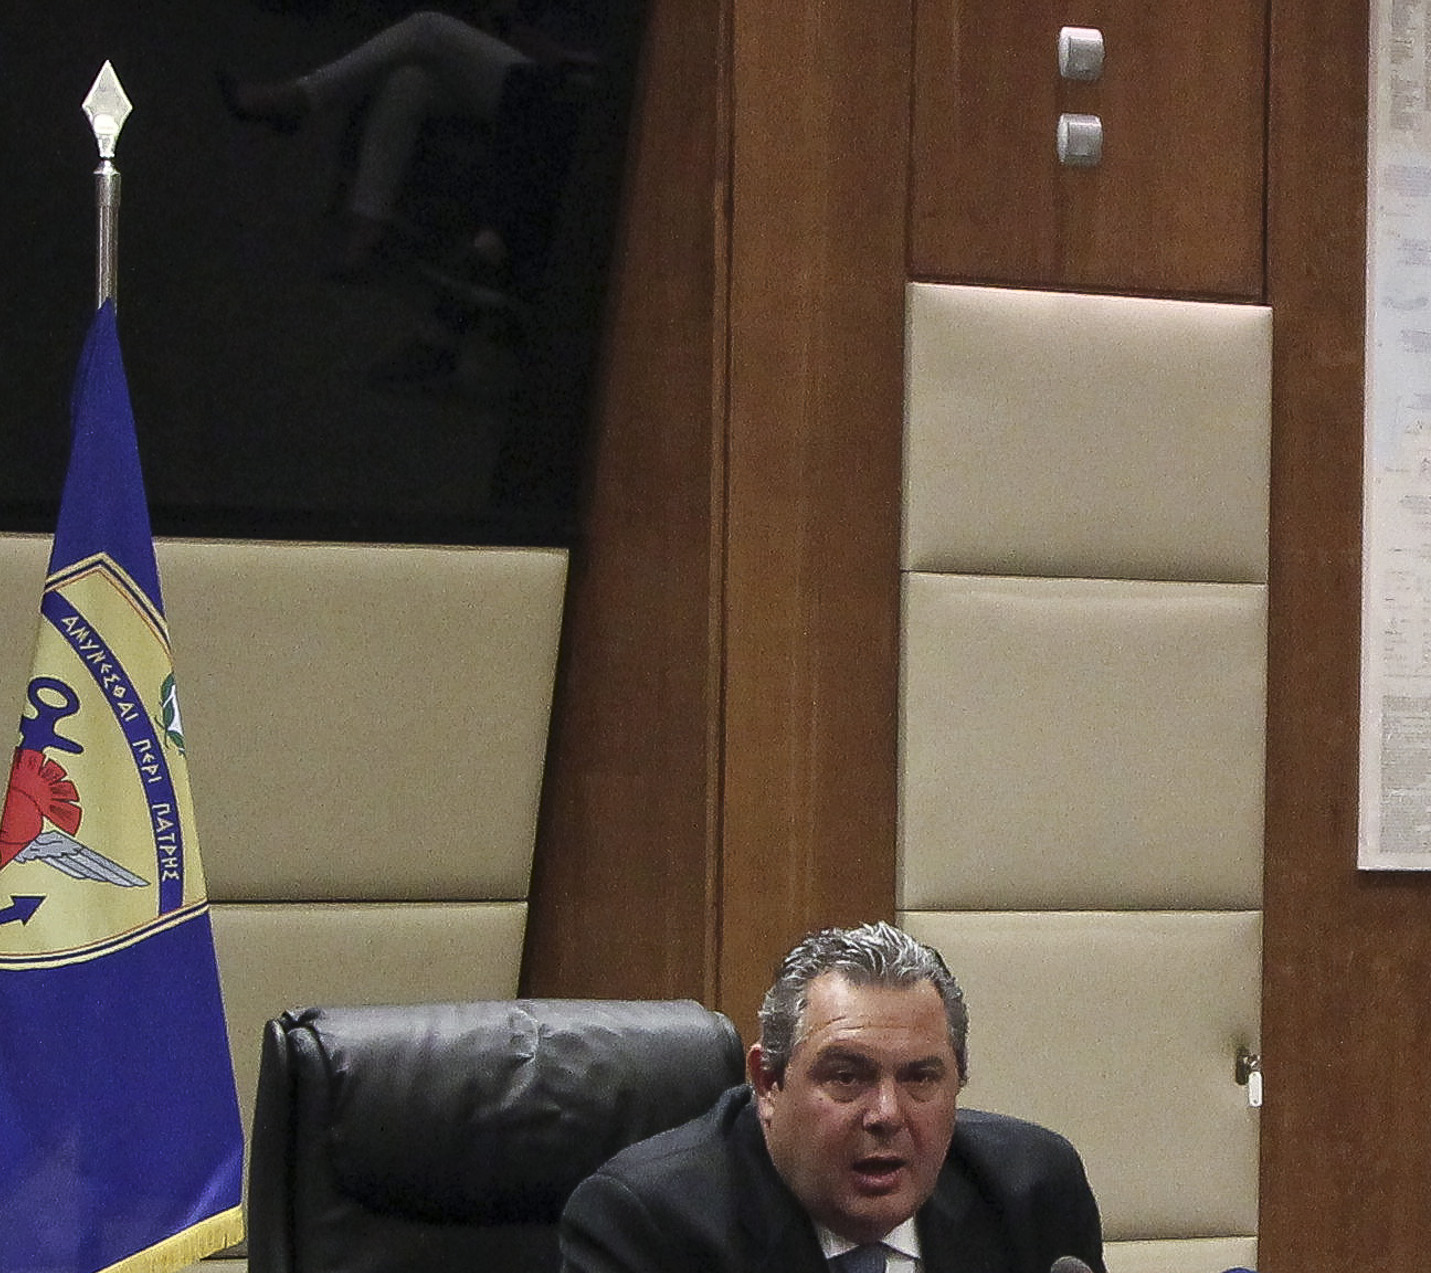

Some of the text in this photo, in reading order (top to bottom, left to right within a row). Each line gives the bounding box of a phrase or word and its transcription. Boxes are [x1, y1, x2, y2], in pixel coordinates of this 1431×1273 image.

[61, 616, 180, 883] ΑΜΥΝΕΣΘΑΙ ΠΕΡΙ ΠΑΤΡΗΣ
